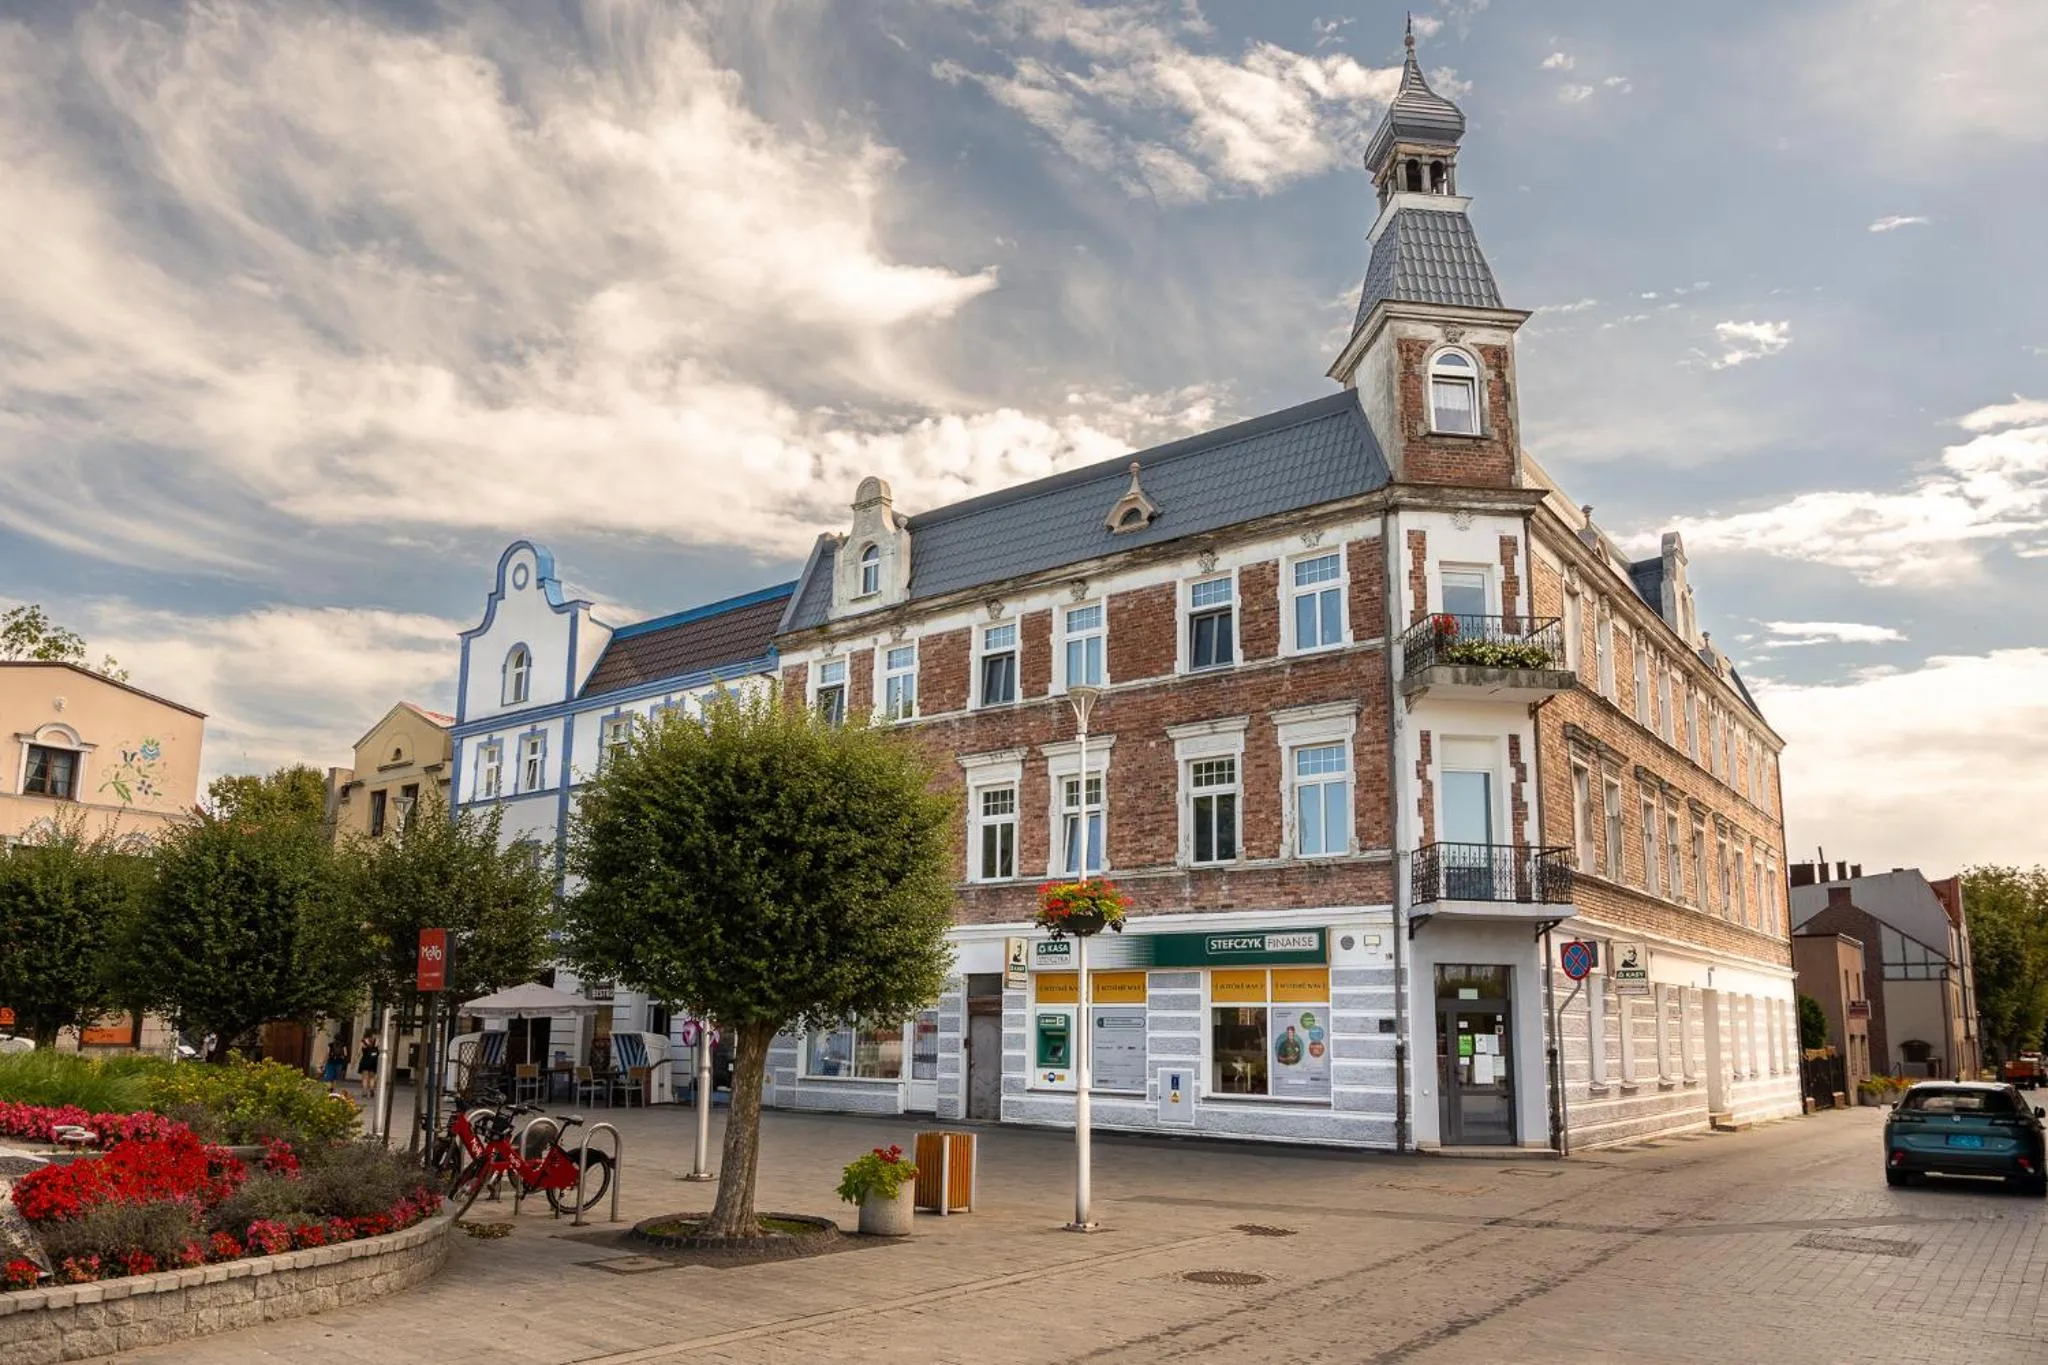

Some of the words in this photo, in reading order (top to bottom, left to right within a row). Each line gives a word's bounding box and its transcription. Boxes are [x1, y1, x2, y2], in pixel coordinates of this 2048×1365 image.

[1047, 943, 1068, 953] KASA
[1211, 938, 1262, 950] STEFCZYK
[1268, 936, 1314, 948] FINANSE
